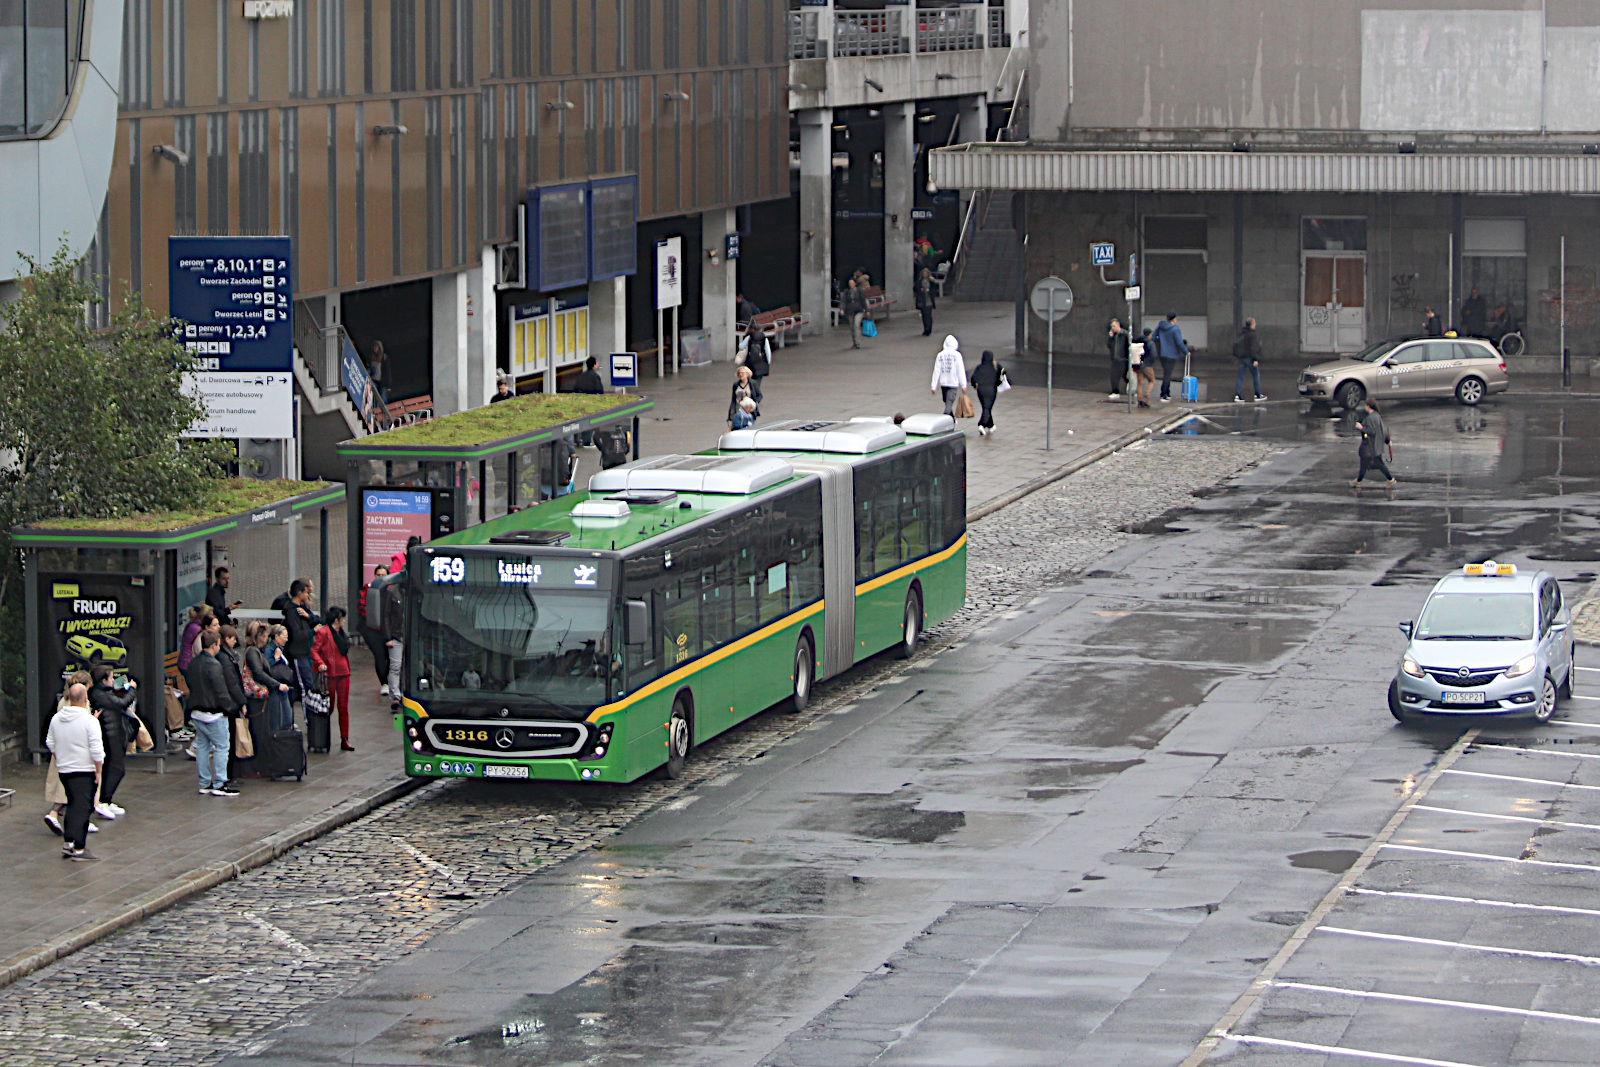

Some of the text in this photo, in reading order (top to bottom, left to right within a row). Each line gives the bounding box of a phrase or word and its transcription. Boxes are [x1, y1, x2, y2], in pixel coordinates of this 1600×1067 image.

[1094, 246, 1113, 258] TAXI
[180, 259, 262, 273] perony ,8,10,1
[232, 292, 262, 304] peron 9
[199, 325, 267, 339] perony 1,2,3,4
[226, 391, 263, 399] autobusowy
[366, 516, 403, 525] ZACZYTANI
[430, 556, 465, 583] 159
[73, 599, 117, 615] FRUGO
[59, 616, 131, 633] I WYGRYWASZ!
[1446, 693, 1458, 701] PO
[445, 729, 488, 741] 1316
[501, 767, 527, 777] 52256
